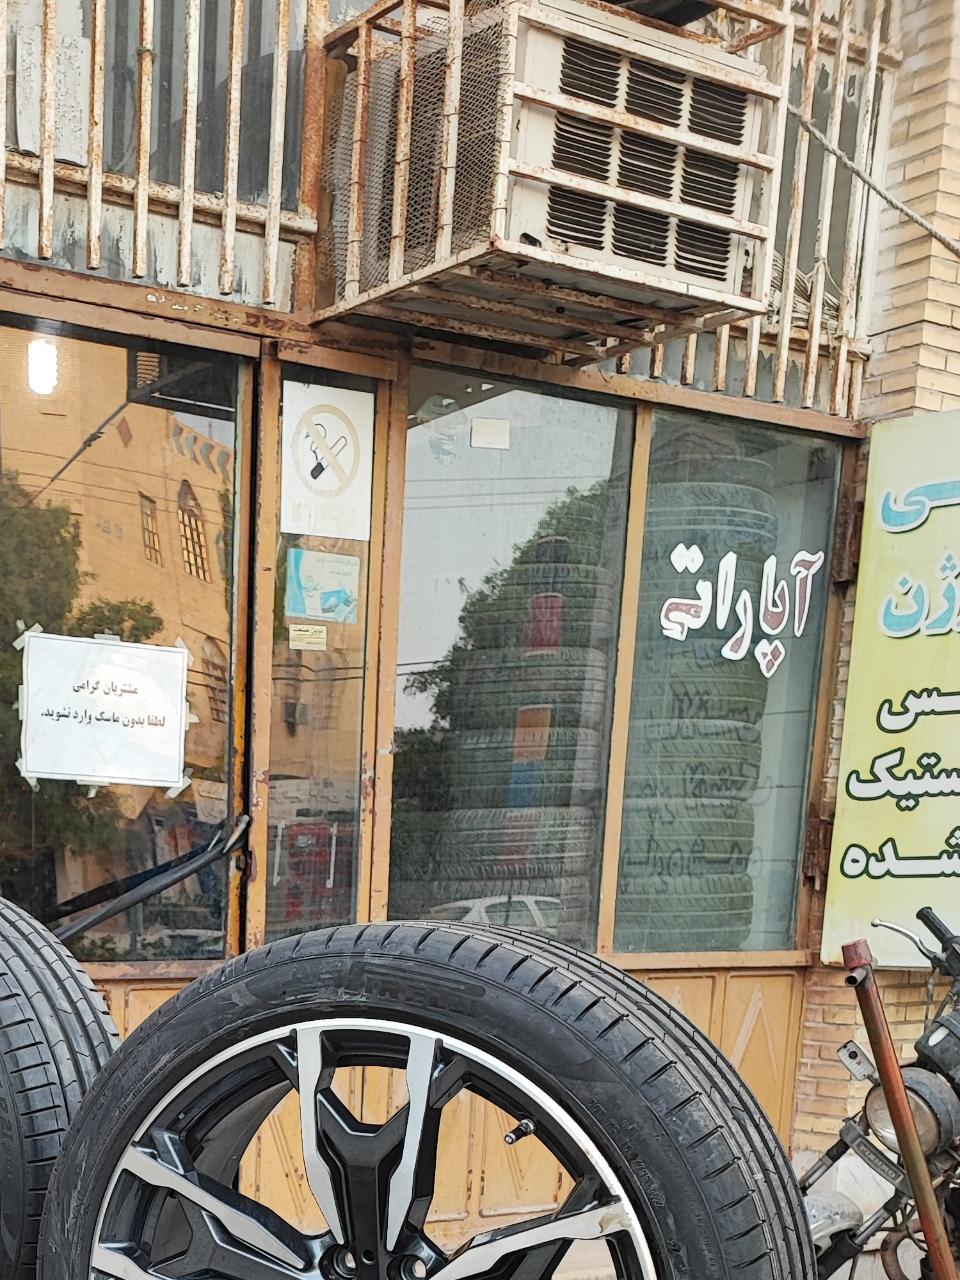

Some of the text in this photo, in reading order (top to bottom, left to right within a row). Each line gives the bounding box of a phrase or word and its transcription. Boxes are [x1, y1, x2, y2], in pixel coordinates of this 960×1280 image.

[660, 542, 824, 678] آپاراتی
[72, 680, 138, 697] مشتریان گرامی
[73, 709, 93, 725] وارد
[95, 710, 120, 723] ماسک
[122, 715, 146, 728] بدون
[147, 715, 166, 728] لطفا
